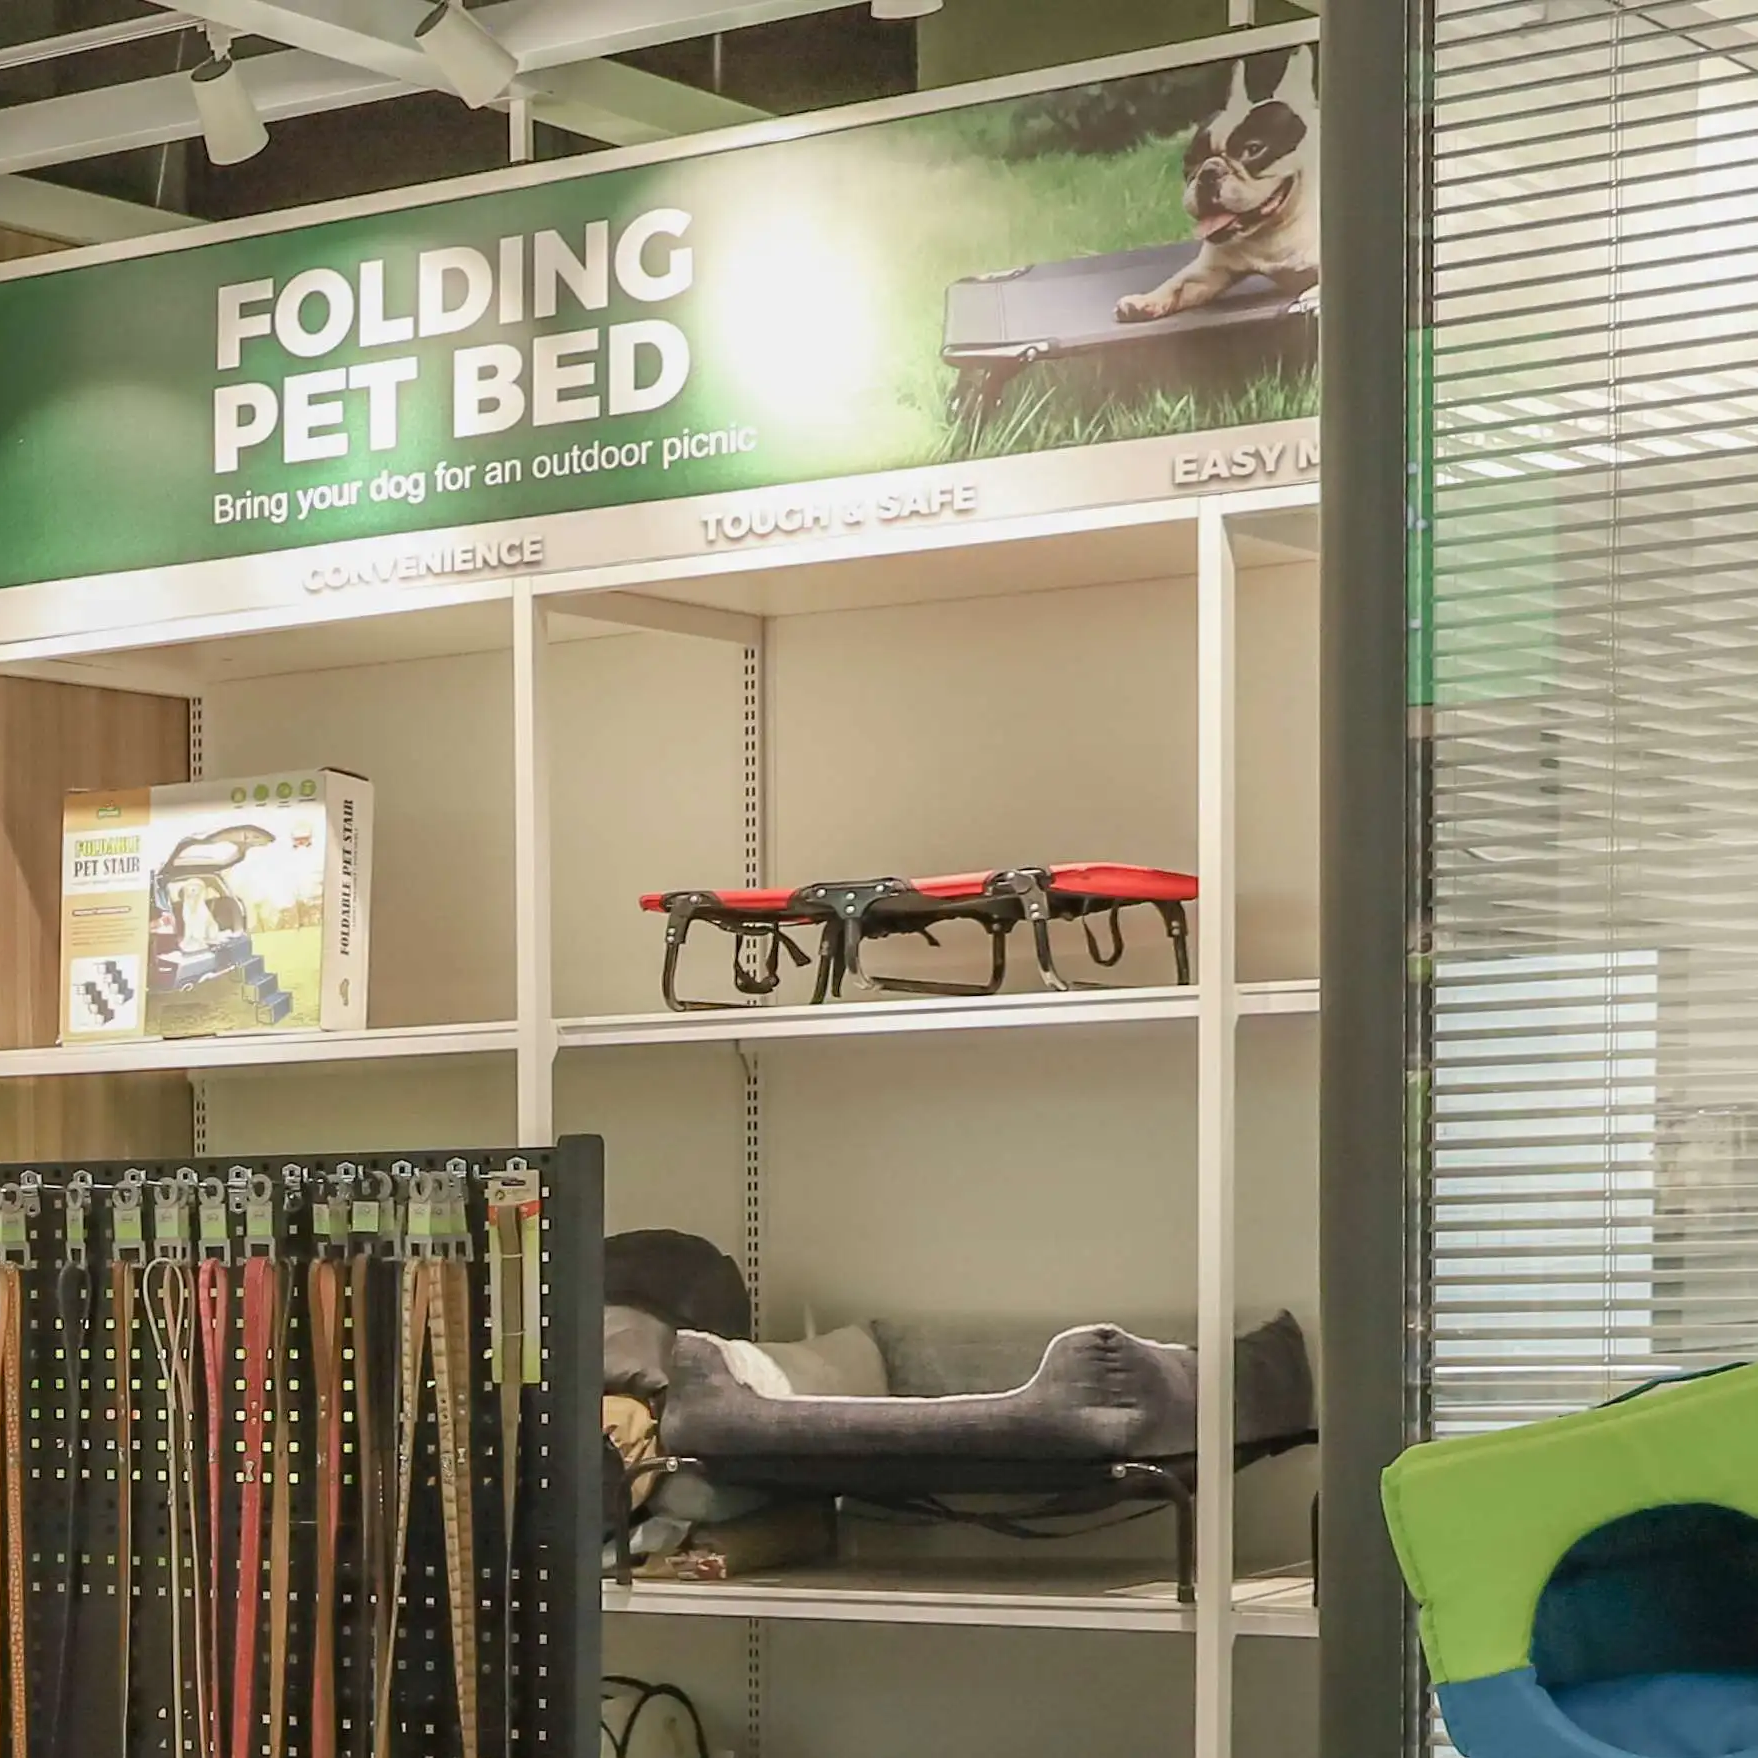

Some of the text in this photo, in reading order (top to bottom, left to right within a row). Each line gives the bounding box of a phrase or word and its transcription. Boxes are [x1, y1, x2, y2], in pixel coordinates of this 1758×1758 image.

[215, 207, 693, 370] FOLDING
[211, 320, 691, 475] PET BED
[213, 422, 759, 526] Bring your dog for an outdoor picnic
[1171, 450, 1283, 484] EASY
[700, 480, 977, 542] TOUGH & SAFE
[301, 535, 545, 594] CONVENIENCE
[74, 853, 140, 878] PET STAIR
[340, 799, 355, 957] FOLDABLE PET STAIR
